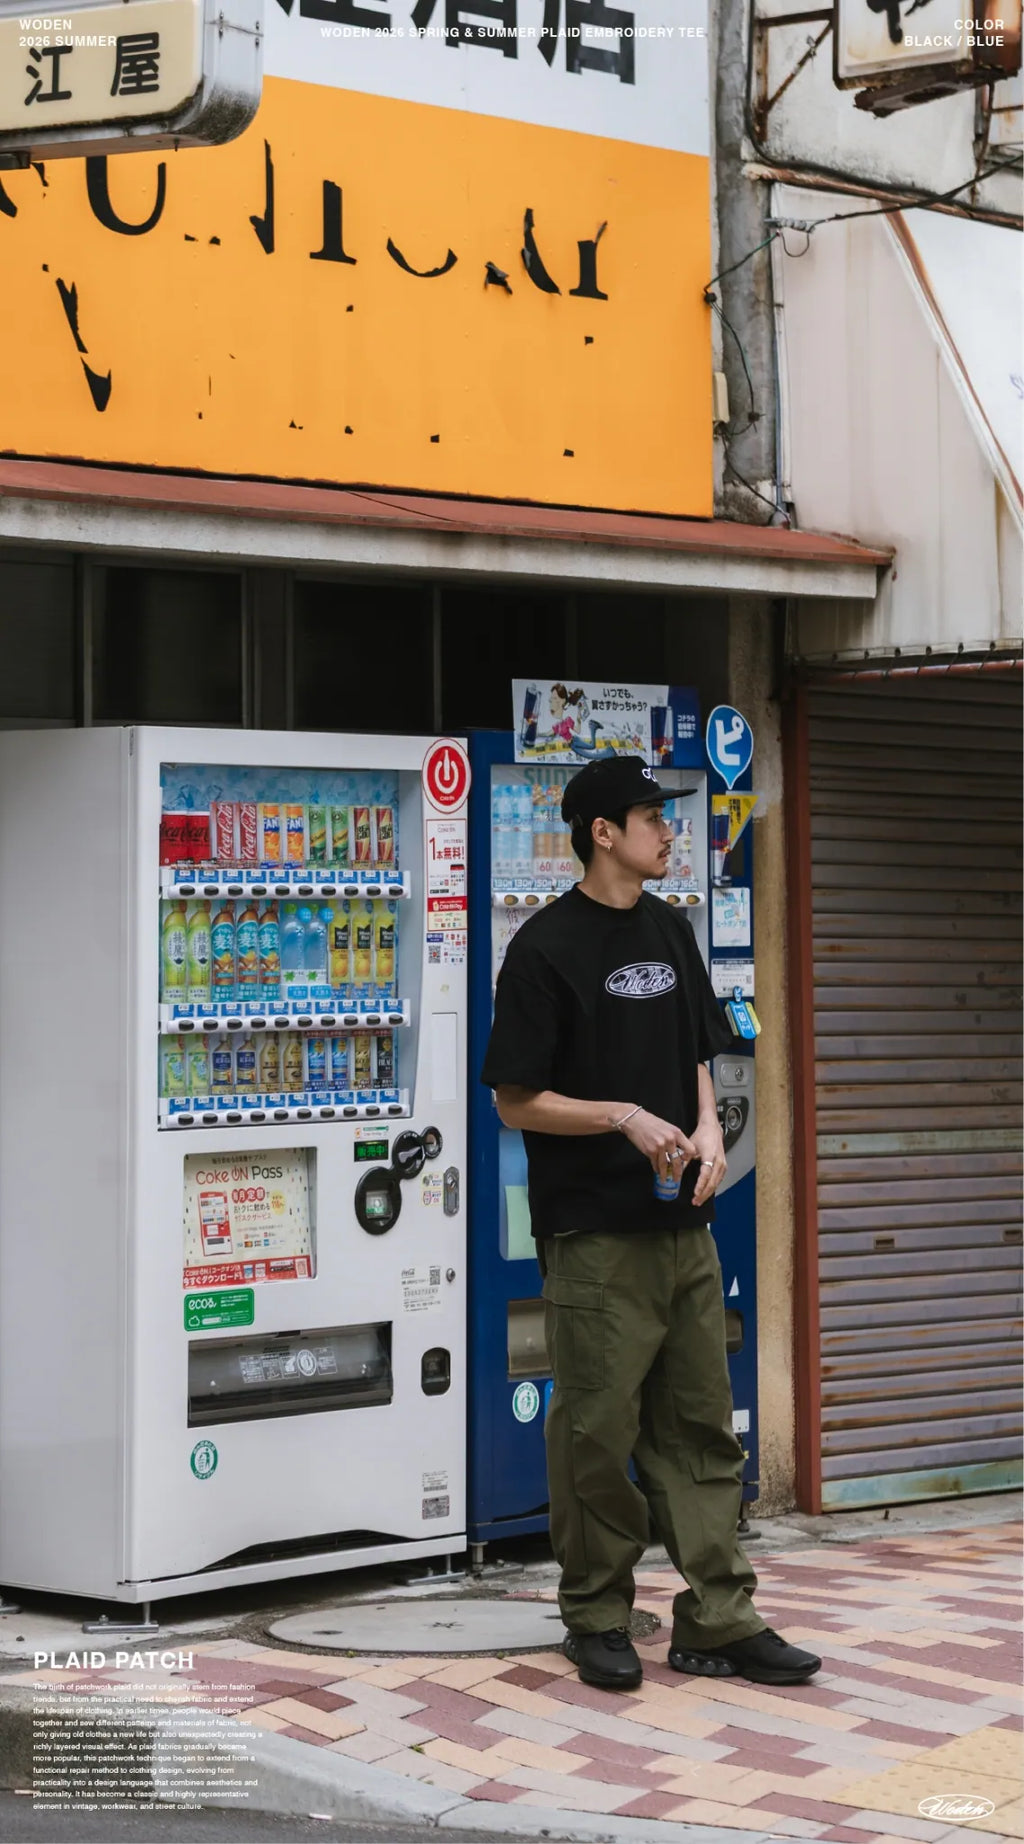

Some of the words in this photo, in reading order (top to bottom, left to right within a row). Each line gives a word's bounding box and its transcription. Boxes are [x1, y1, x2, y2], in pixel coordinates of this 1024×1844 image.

[715, 715, 745, 766] ピ
[195, 1168, 230, 1186] Coke
[251, 1165, 283, 1181] Pass
